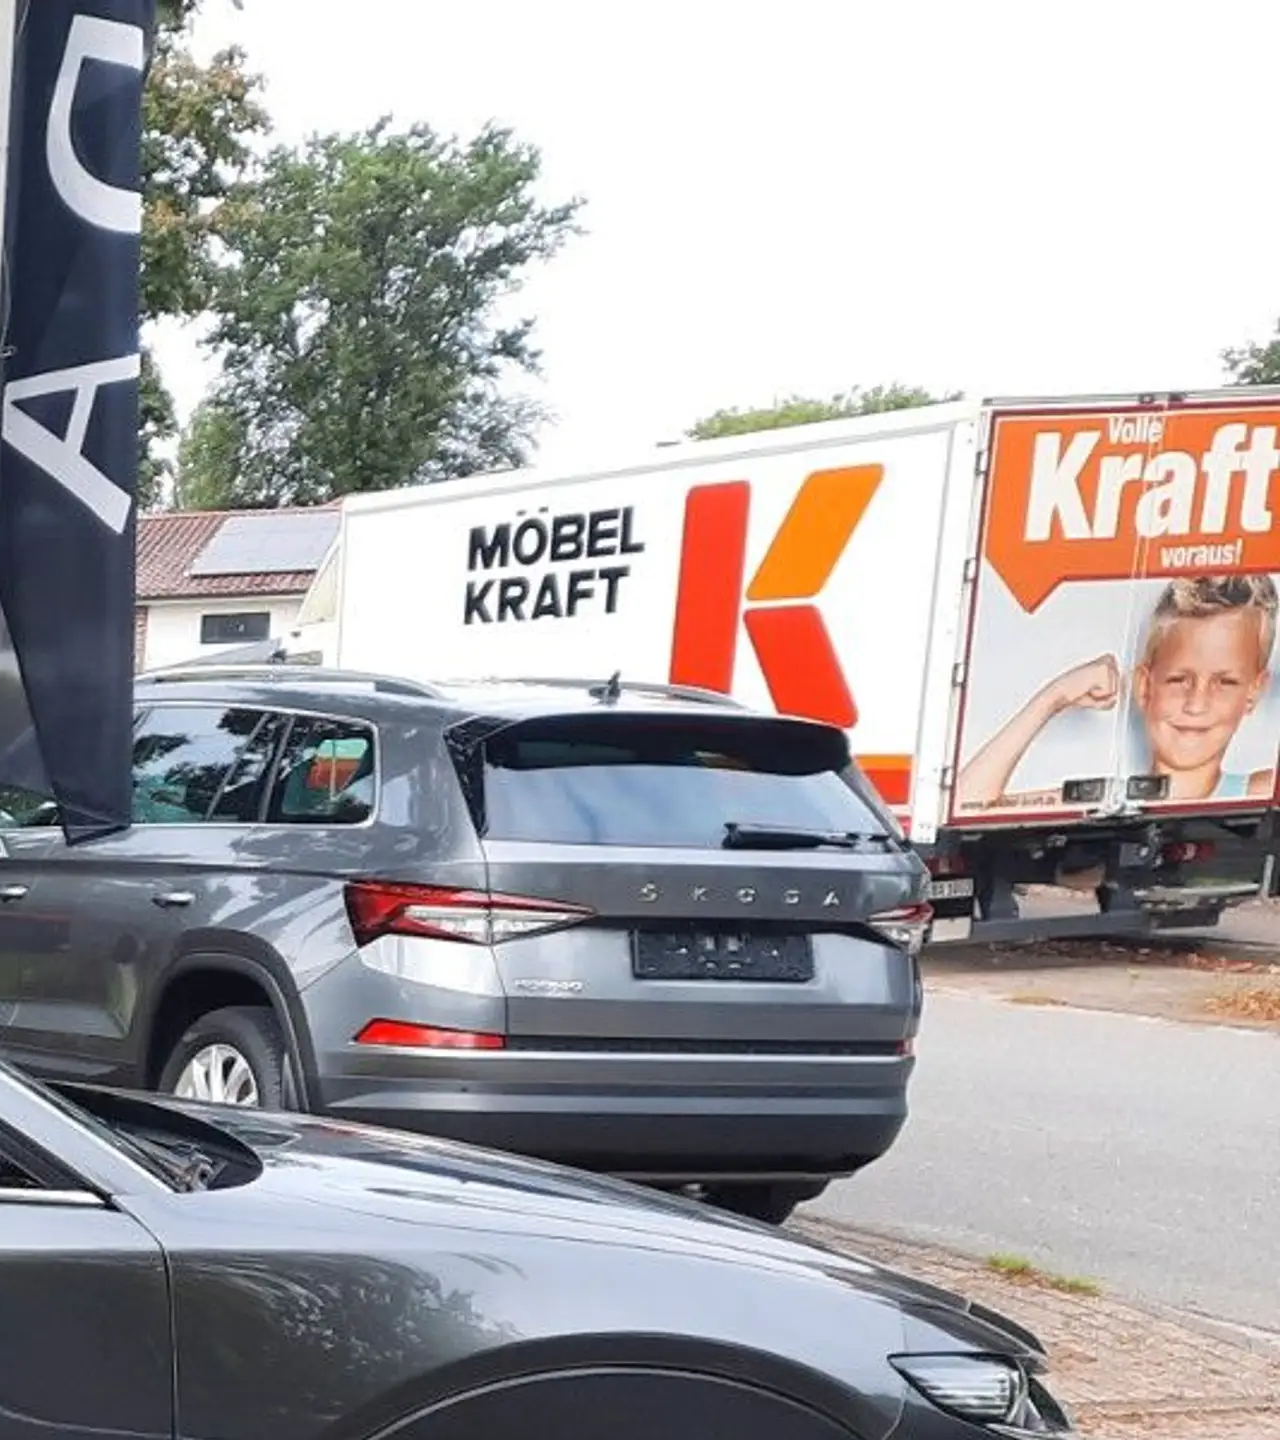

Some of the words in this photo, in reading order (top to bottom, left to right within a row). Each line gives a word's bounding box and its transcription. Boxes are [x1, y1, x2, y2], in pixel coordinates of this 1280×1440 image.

[1108, 415, 1167, 445] Volle
[1023, 422, 1279, 543] Kraft
[467, 505, 646, 571] MÖBEL
[1160, 537, 1243, 568] voraus!
[463, 564, 631, 625] KRAFT
